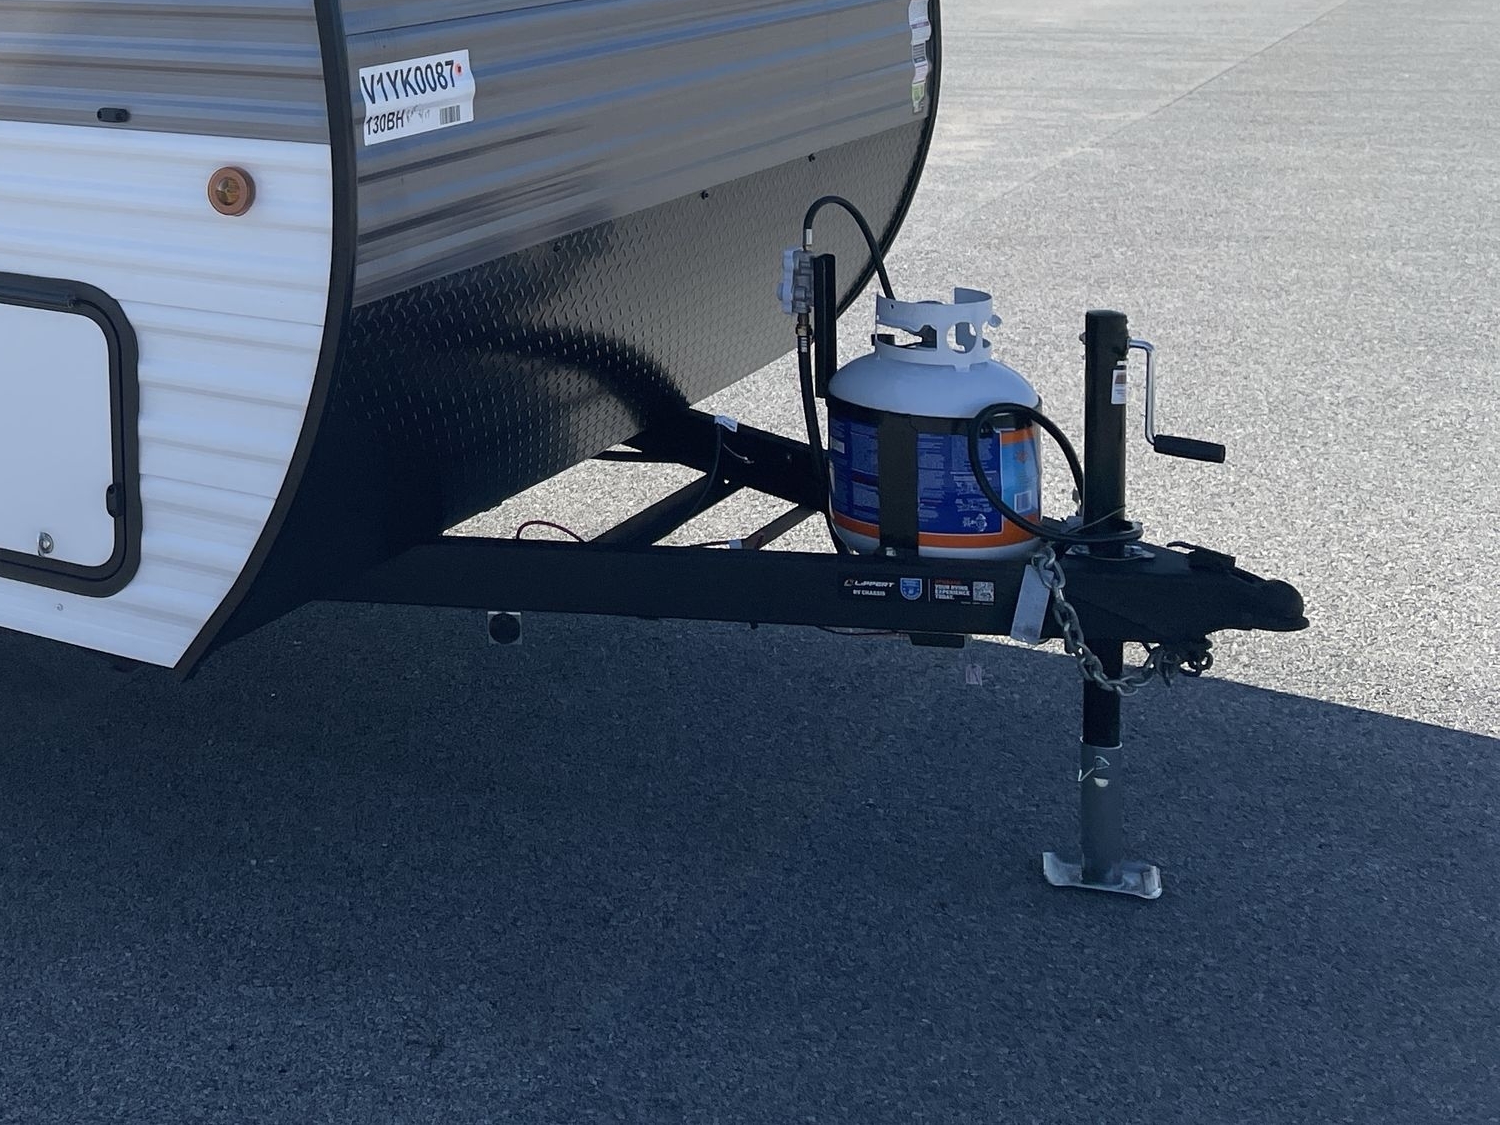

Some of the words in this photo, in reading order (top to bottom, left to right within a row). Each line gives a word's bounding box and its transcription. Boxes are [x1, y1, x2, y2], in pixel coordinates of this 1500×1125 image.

[361, 59, 455, 105] V1YK0087
[365, 109, 406, 136] 130BH
[854, 579, 896, 588] LIPPERT
